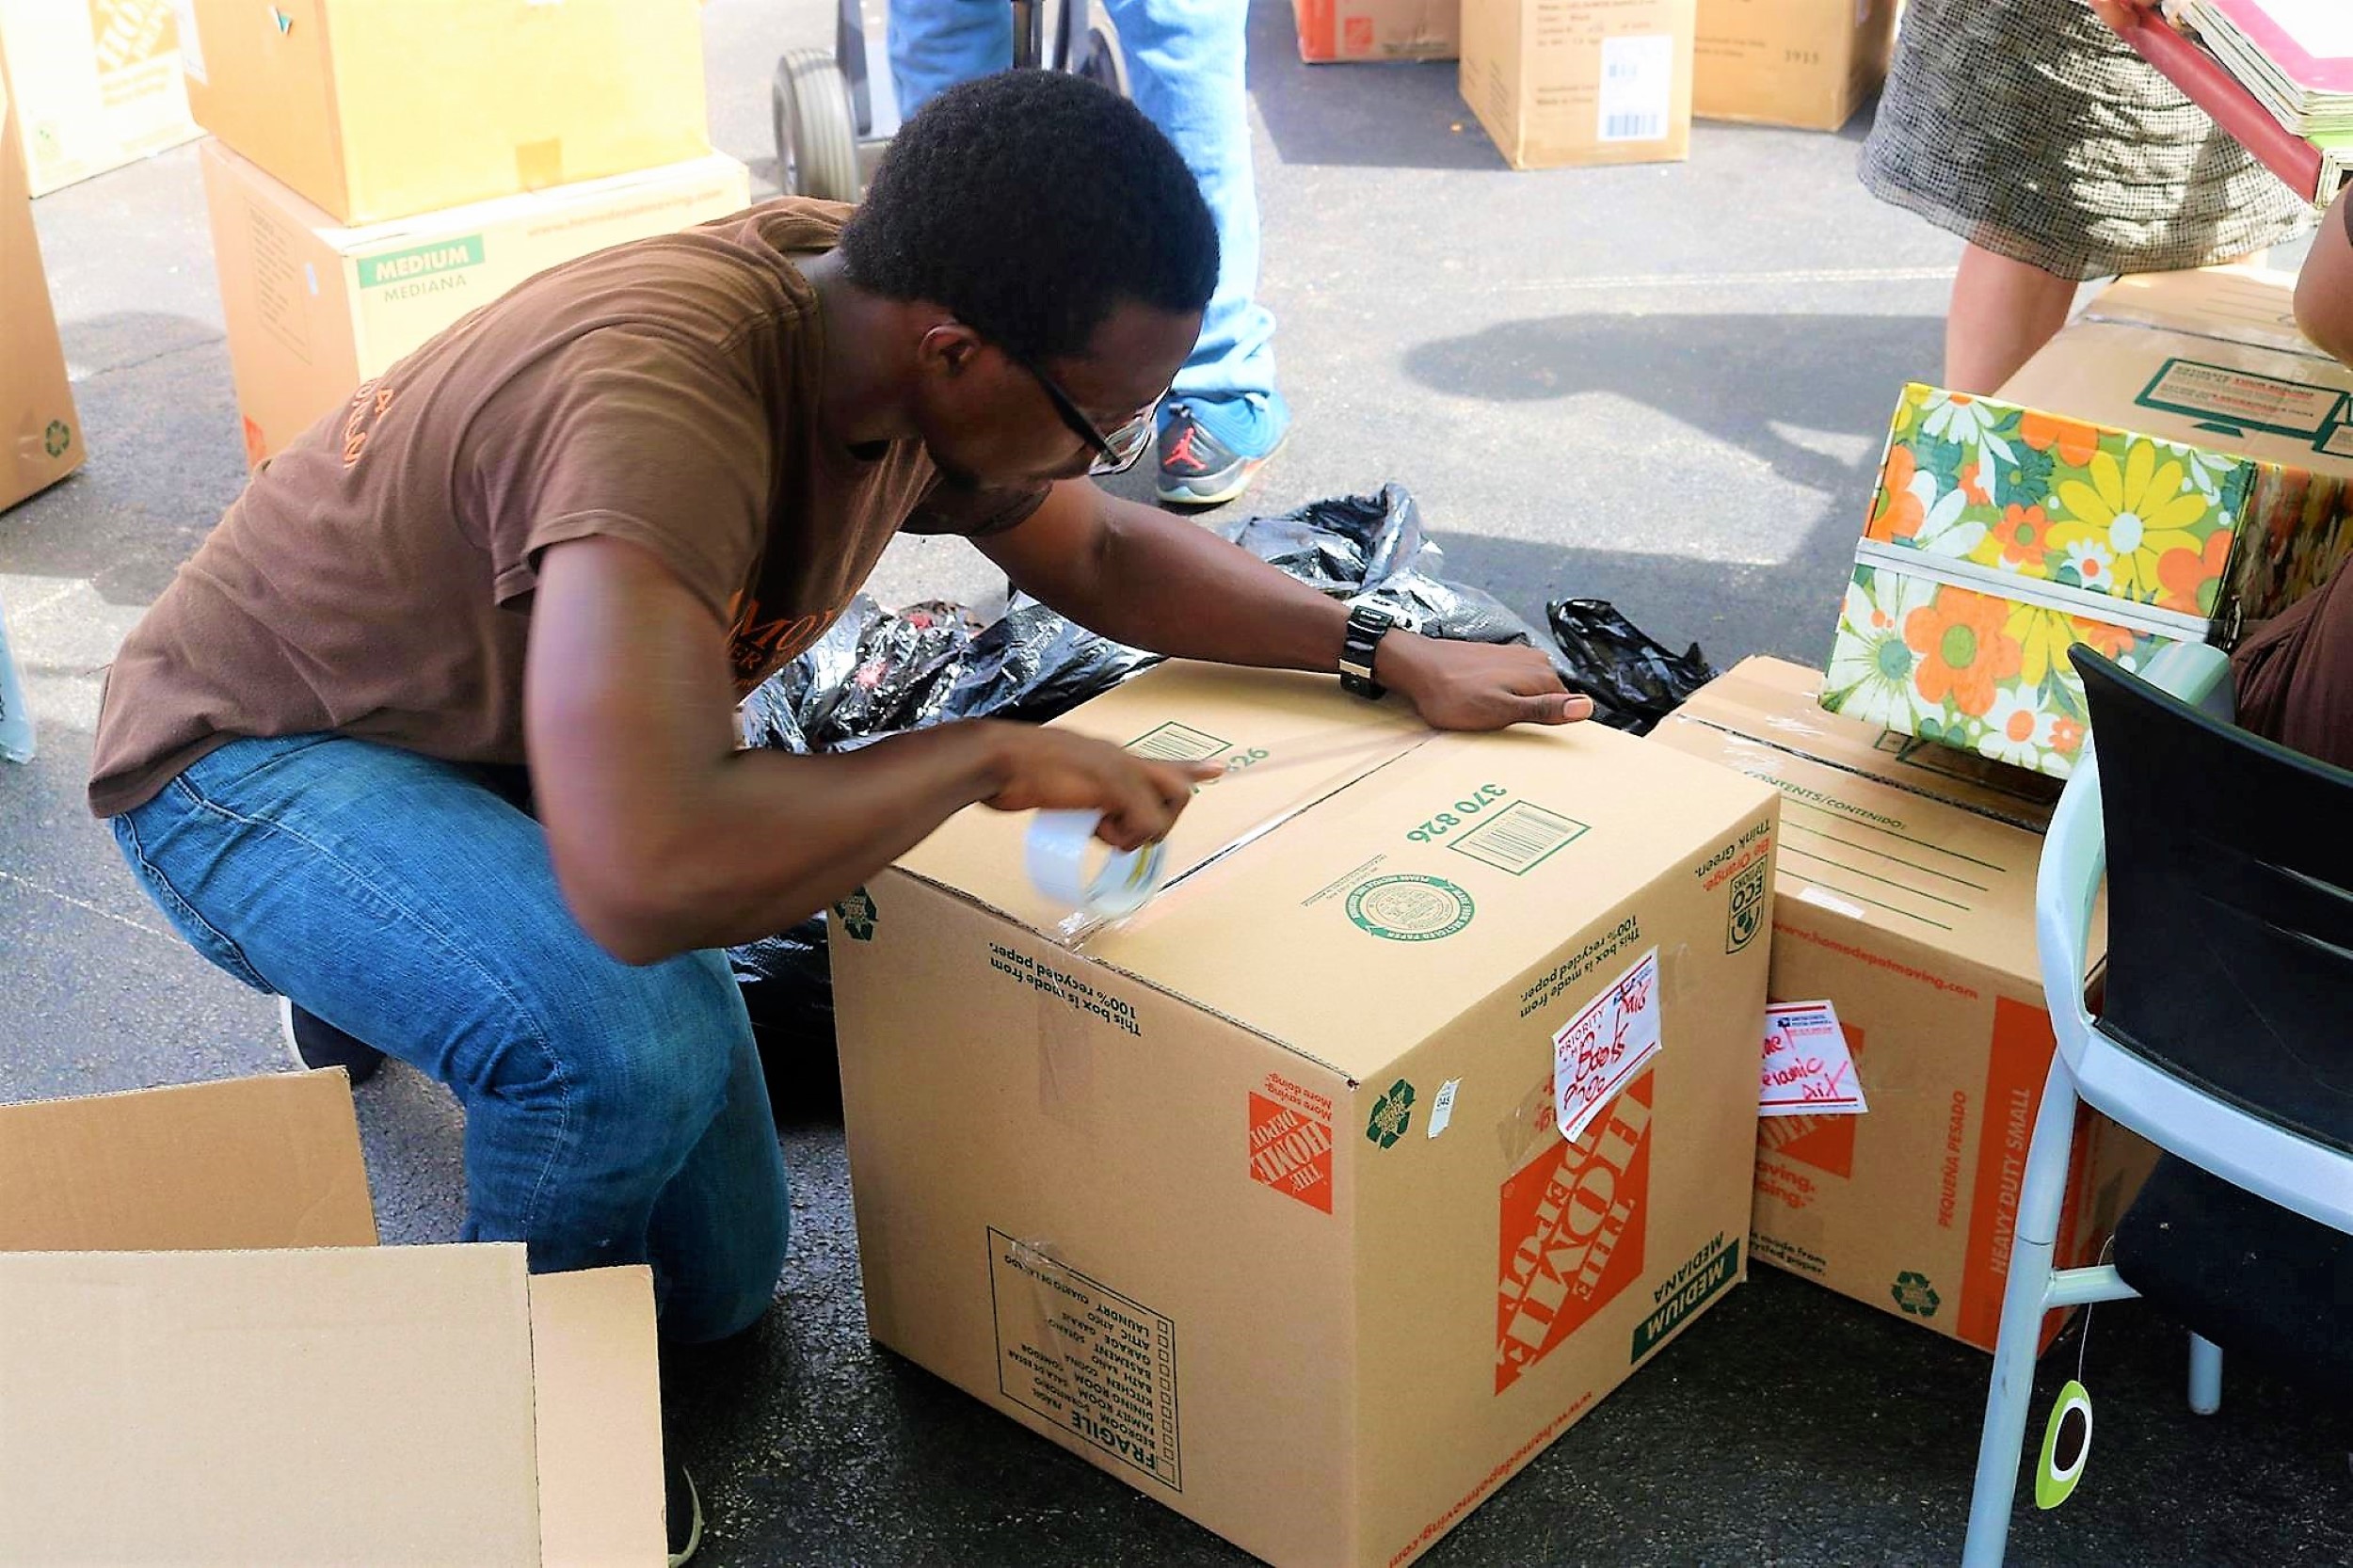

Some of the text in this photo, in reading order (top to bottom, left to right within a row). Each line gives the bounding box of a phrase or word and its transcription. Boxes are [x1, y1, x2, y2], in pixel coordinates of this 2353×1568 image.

[376, 245, 469, 281] MEDIUM
[384, 274, 467, 302] MEDIANA
[1406, 784, 1507, 843] 370 826
[1694, 819, 1771, 877] Think Green.
[1733, 875, 1763, 913] ECO
[1520, 915, 1636, 1001] 100% recycled paper.
[1520, 927, 1640, 1017] This box is made from
[989, 942, 1136, 1019] 100% recycled paper.
[990, 957, 1142, 1037] This box is made from
[1559, 1007, 1606, 1057] PRIORITY
[1303, 1089, 1332, 1109] More
[1304, 1102, 1333, 1121] More
[1250, 1110, 1298, 1148] DEPOT
[1947, 1090, 1966, 1154] PESADO
[1251, 1121, 1332, 1185] HOME
[1289, 1163, 1323, 1194] THE
[1990, 1088, 2031, 1276] HEAVY DUTY SMALL
[1497, 1130, 1596, 1312] DEPOT
[1497, 1092, 1651, 1376] HOME
[1573, 1198, 1636, 1301] THE
[1654, 1230, 1723, 1304] MEDIANA
[1647, 1256, 1724, 1340] MEDIUM
[1096, 1301, 1149, 1337] LAUNDRY
[1104, 1334, 1150, 1367] GARAGE
[1120, 1328, 1149, 1352] ATTIC
[1093, 1342, 1151, 1380] BASEMENT
[1074, 1371, 1109, 1398] ROOM
[1078, 1386, 1112, 1413] ROOM
[1106, 1375, 1152, 1408] KITCHEN
[1124, 1371, 1152, 1394] BATH
[1112, 1392, 1153, 1422] DINING
[1116, 1407, 1154, 1435] FAMILY
[1070, 1409, 1156, 1471] FRAGILE
[1099, 1412, 1154, 1449] BEDROOM
